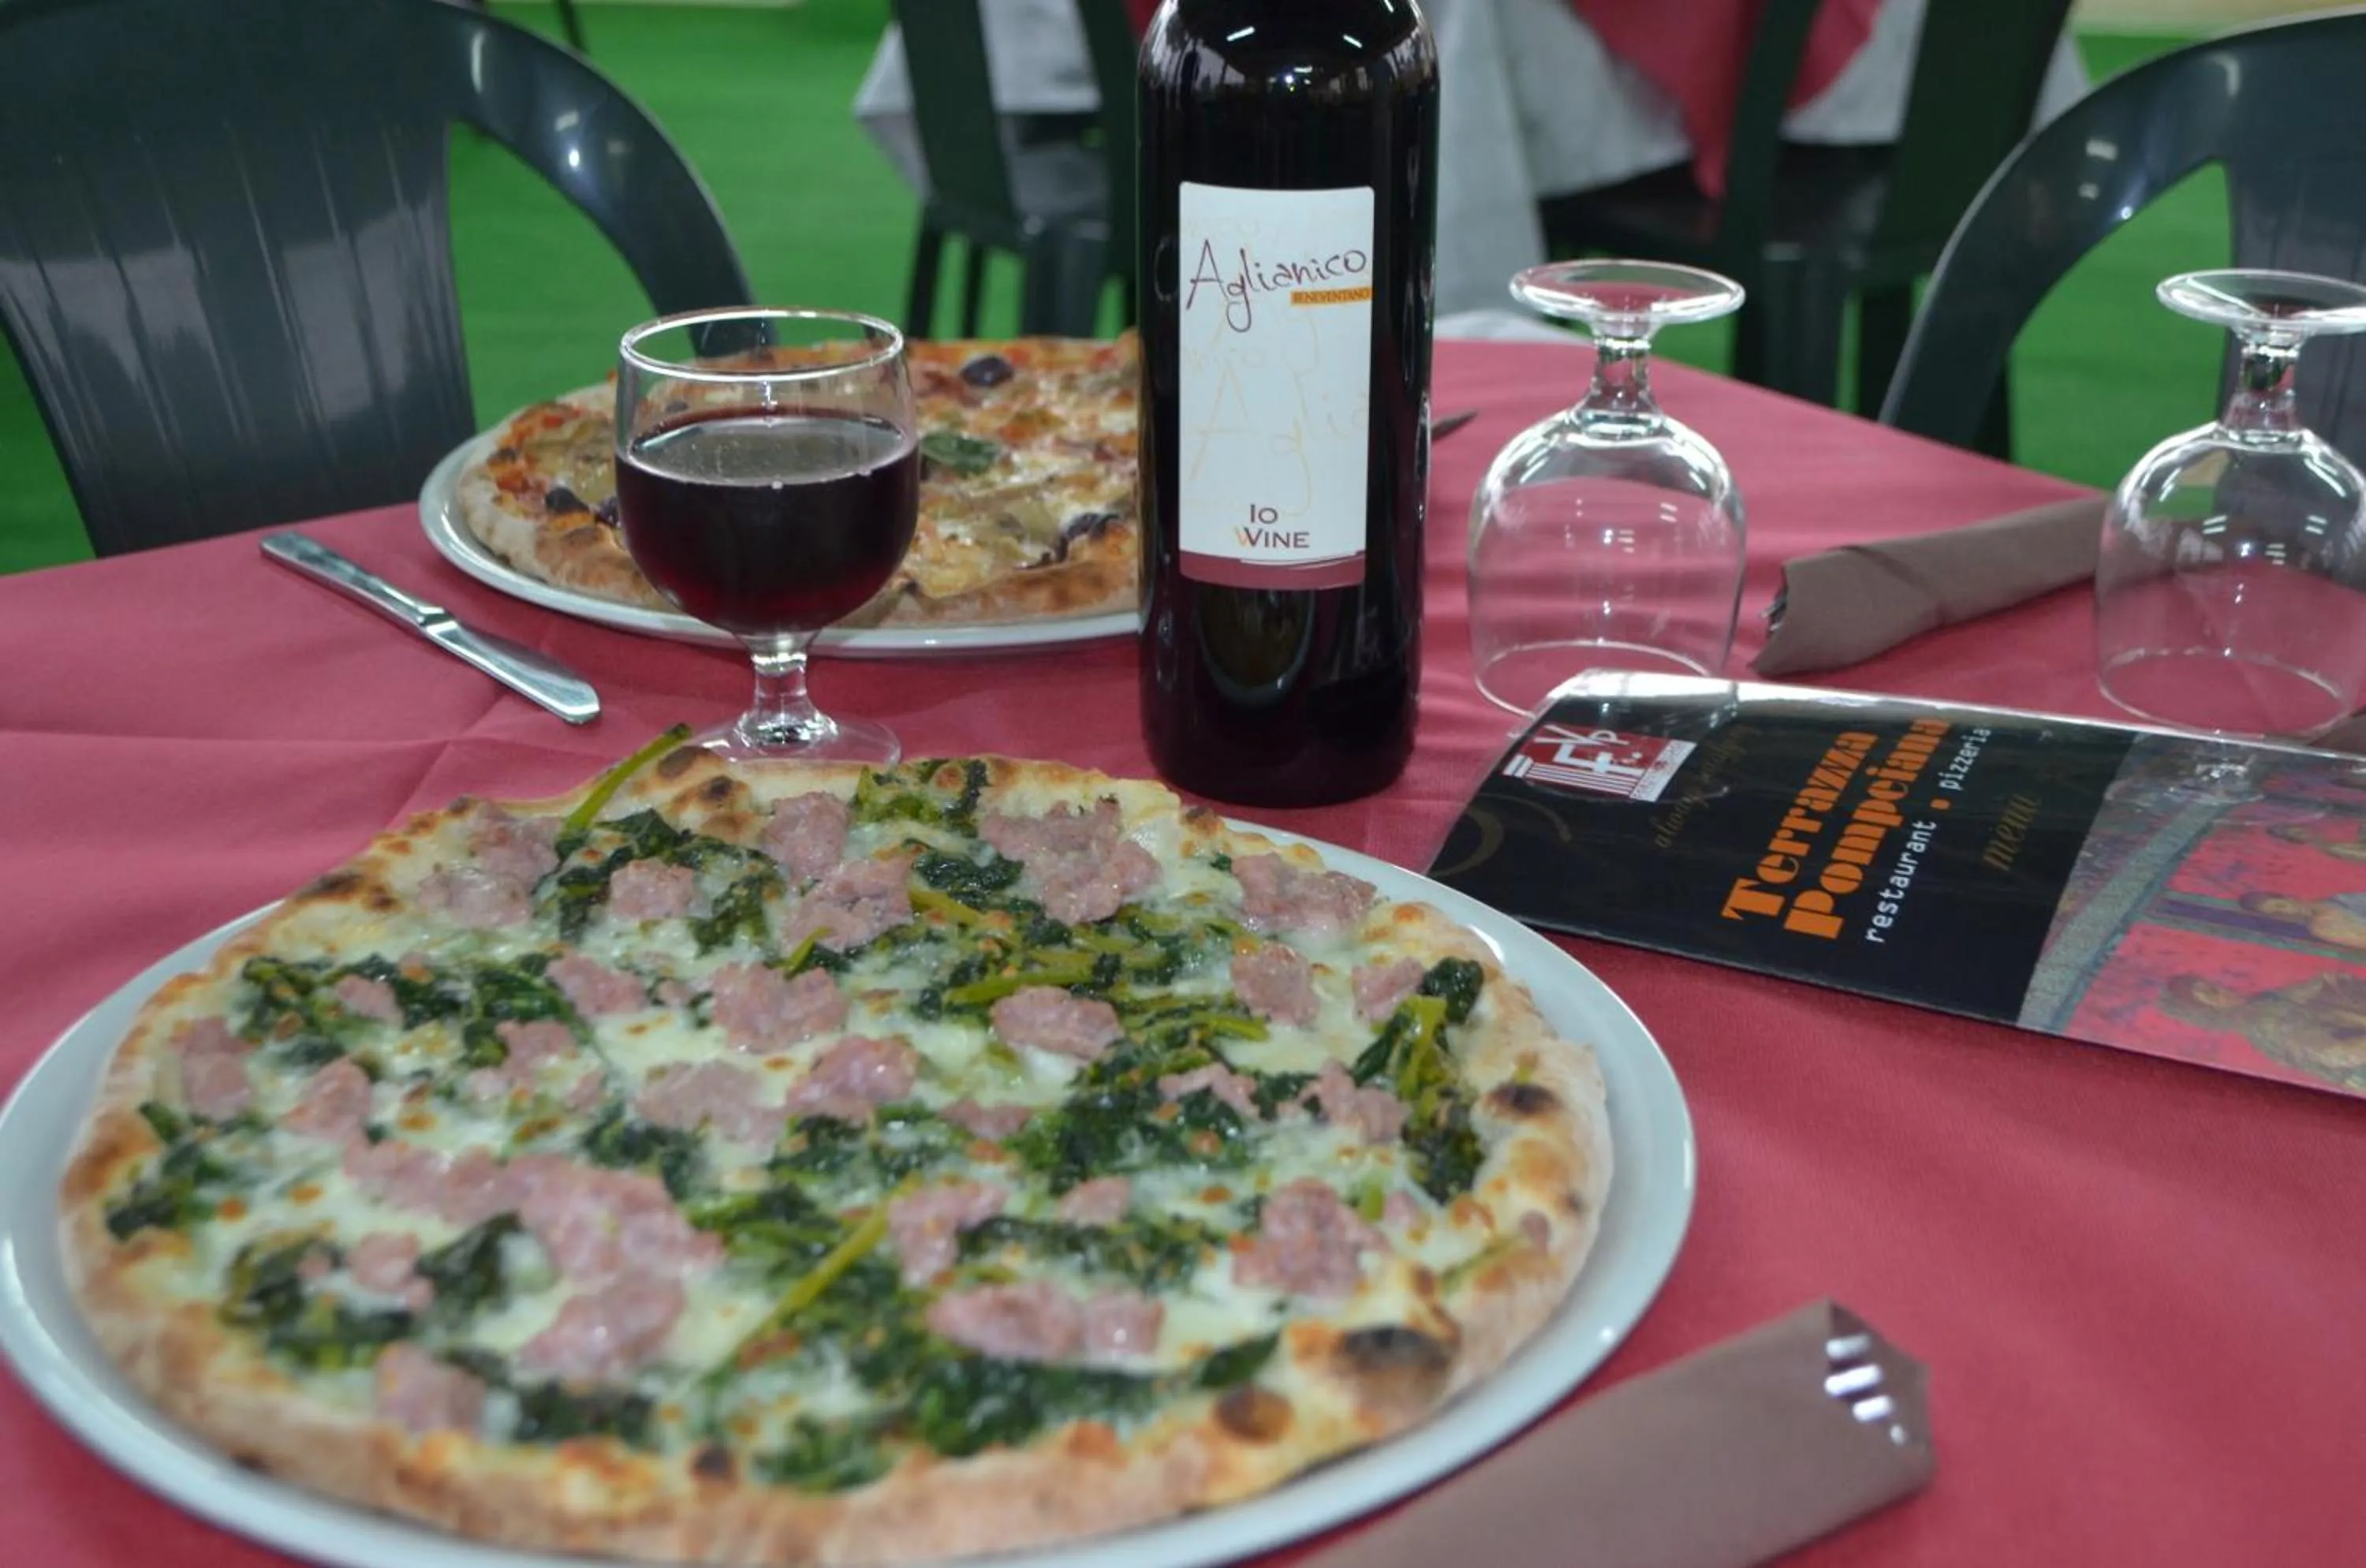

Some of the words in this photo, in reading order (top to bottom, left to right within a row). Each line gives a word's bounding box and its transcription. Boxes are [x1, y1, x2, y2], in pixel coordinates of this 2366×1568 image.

[1185, 239, 1367, 333] Aglianico
[1721, 731, 1879, 921] Terrazza
[1783, 719, 1951, 939] Pompeiana
[1865, 819, 1936, 943] restaurant
[1939, 727, 1991, 790] pizzeria
